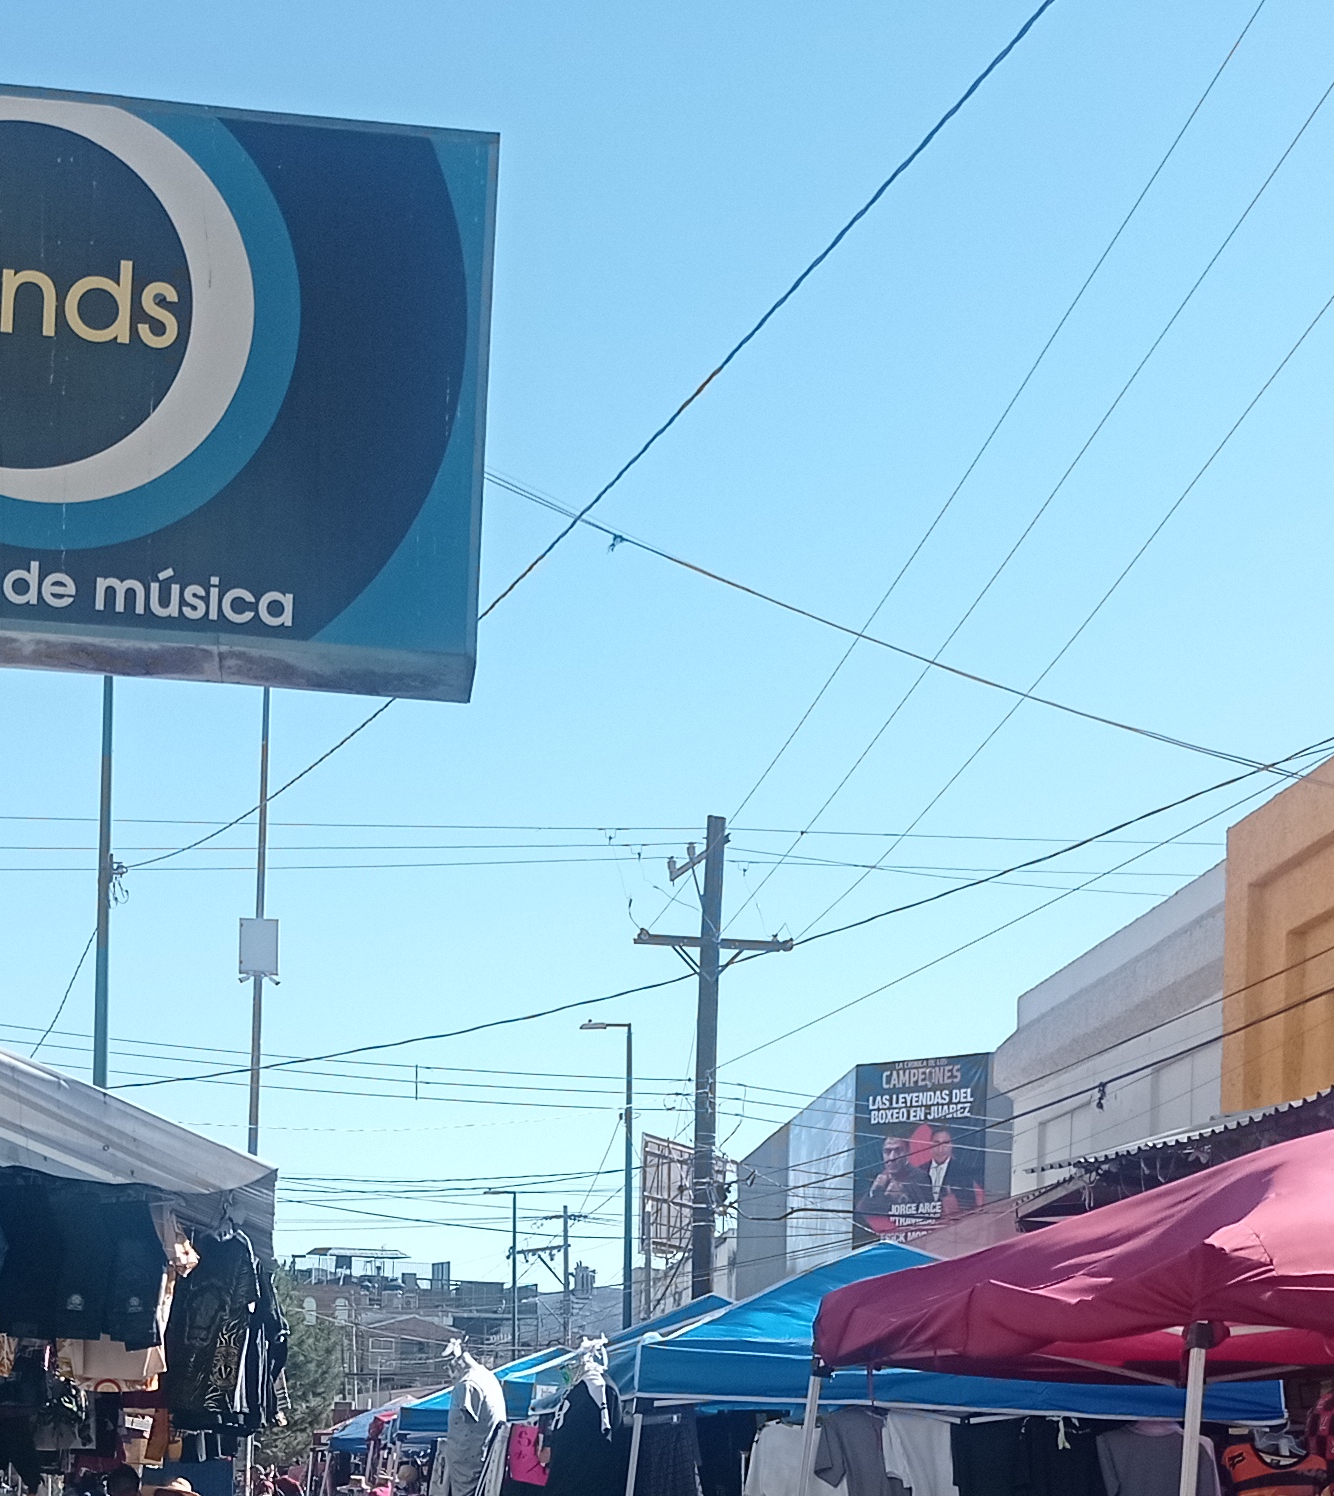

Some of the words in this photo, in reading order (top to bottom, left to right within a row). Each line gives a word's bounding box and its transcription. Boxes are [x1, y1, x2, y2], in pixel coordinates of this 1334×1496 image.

[3, 559, 76, 608] de
[95, 567, 295, 628] música
[882, 1065, 962, 1089] CAMPEONES
[868, 1096, 890, 1110] LAS
[892, 1090, 950, 1108] LEYENDAS
[951, 1088, 974, 1103] DEL
[870, 1108, 907, 1125] BOXEO
[909, 1106, 925, 1121] EN
[888, 1203, 917, 1214] JORGE
[918, 1202, 942, 1214] ARCE
